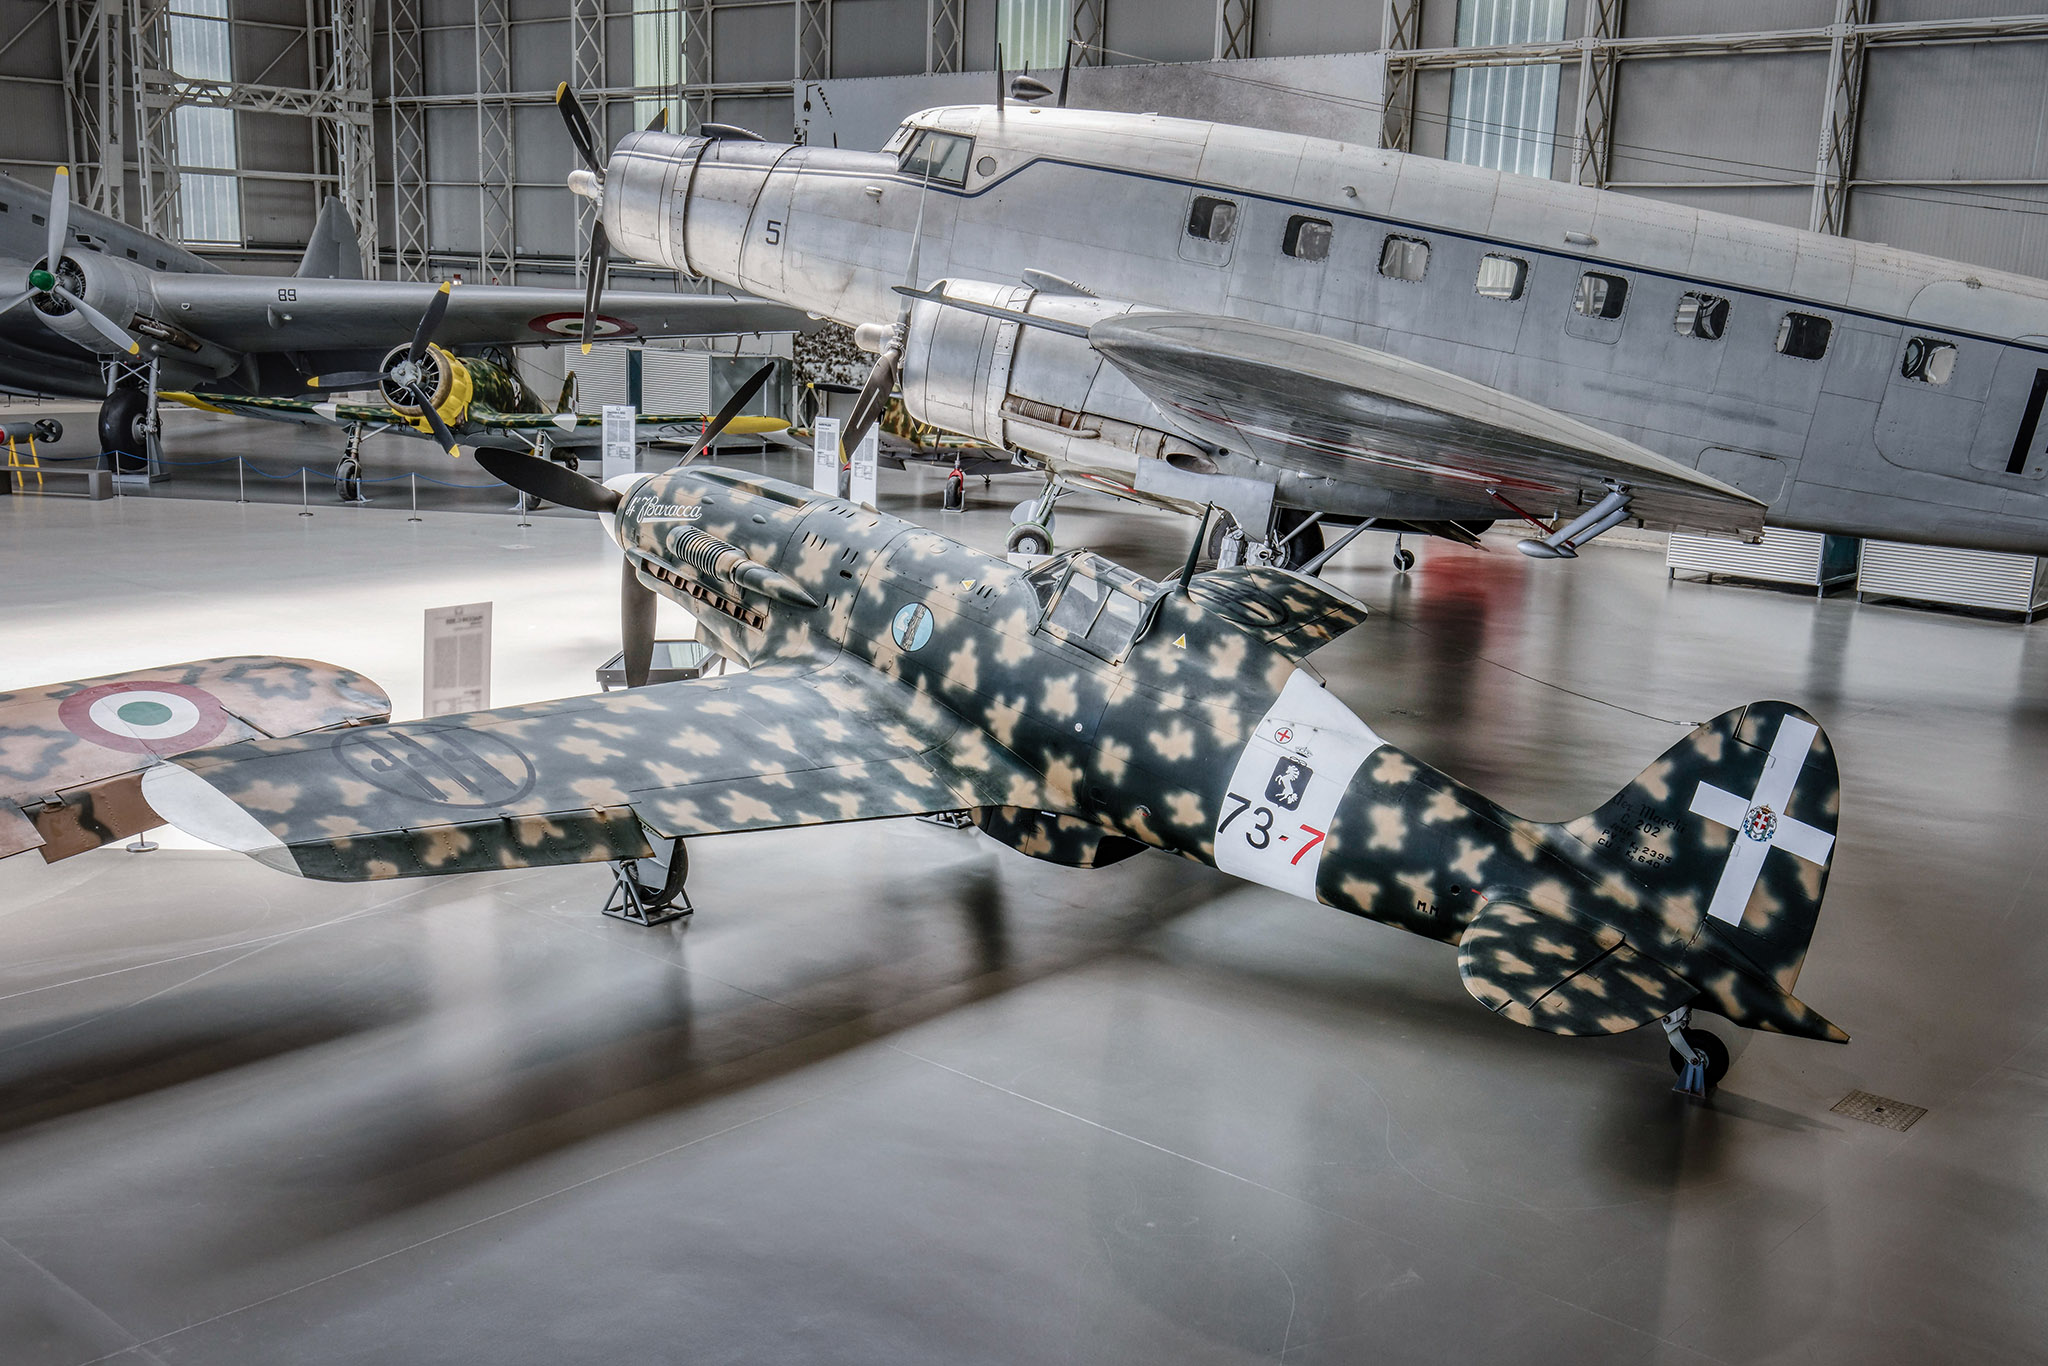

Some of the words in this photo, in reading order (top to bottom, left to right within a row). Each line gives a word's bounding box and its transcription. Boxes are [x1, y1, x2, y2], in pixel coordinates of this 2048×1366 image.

[765, 219, 782, 246] 5
[278, 288, 297, 302] 89
[1634, 819, 1661, 838] 202
